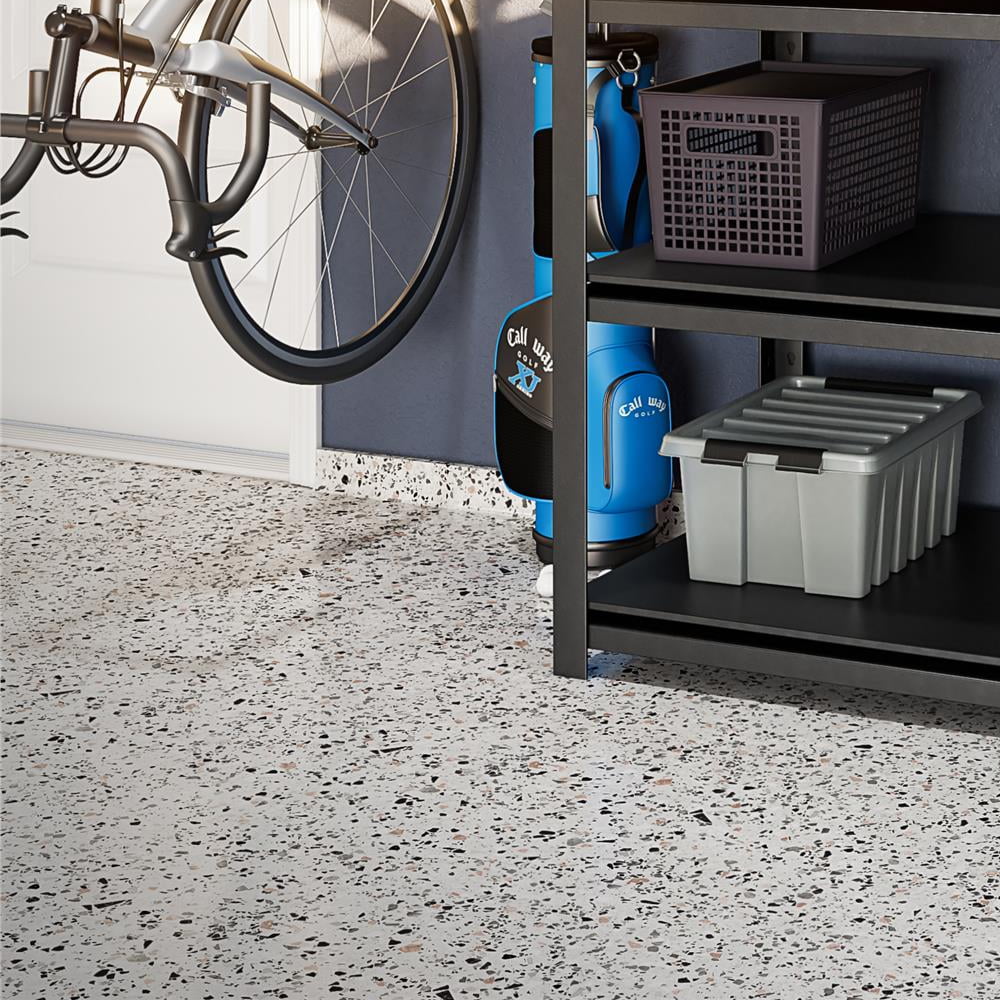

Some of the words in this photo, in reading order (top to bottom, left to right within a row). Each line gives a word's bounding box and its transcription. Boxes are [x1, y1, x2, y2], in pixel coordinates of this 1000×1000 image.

[506, 326, 528, 347] Call
[619, 395, 643, 417] Call
[647, 396, 667, 412] way
